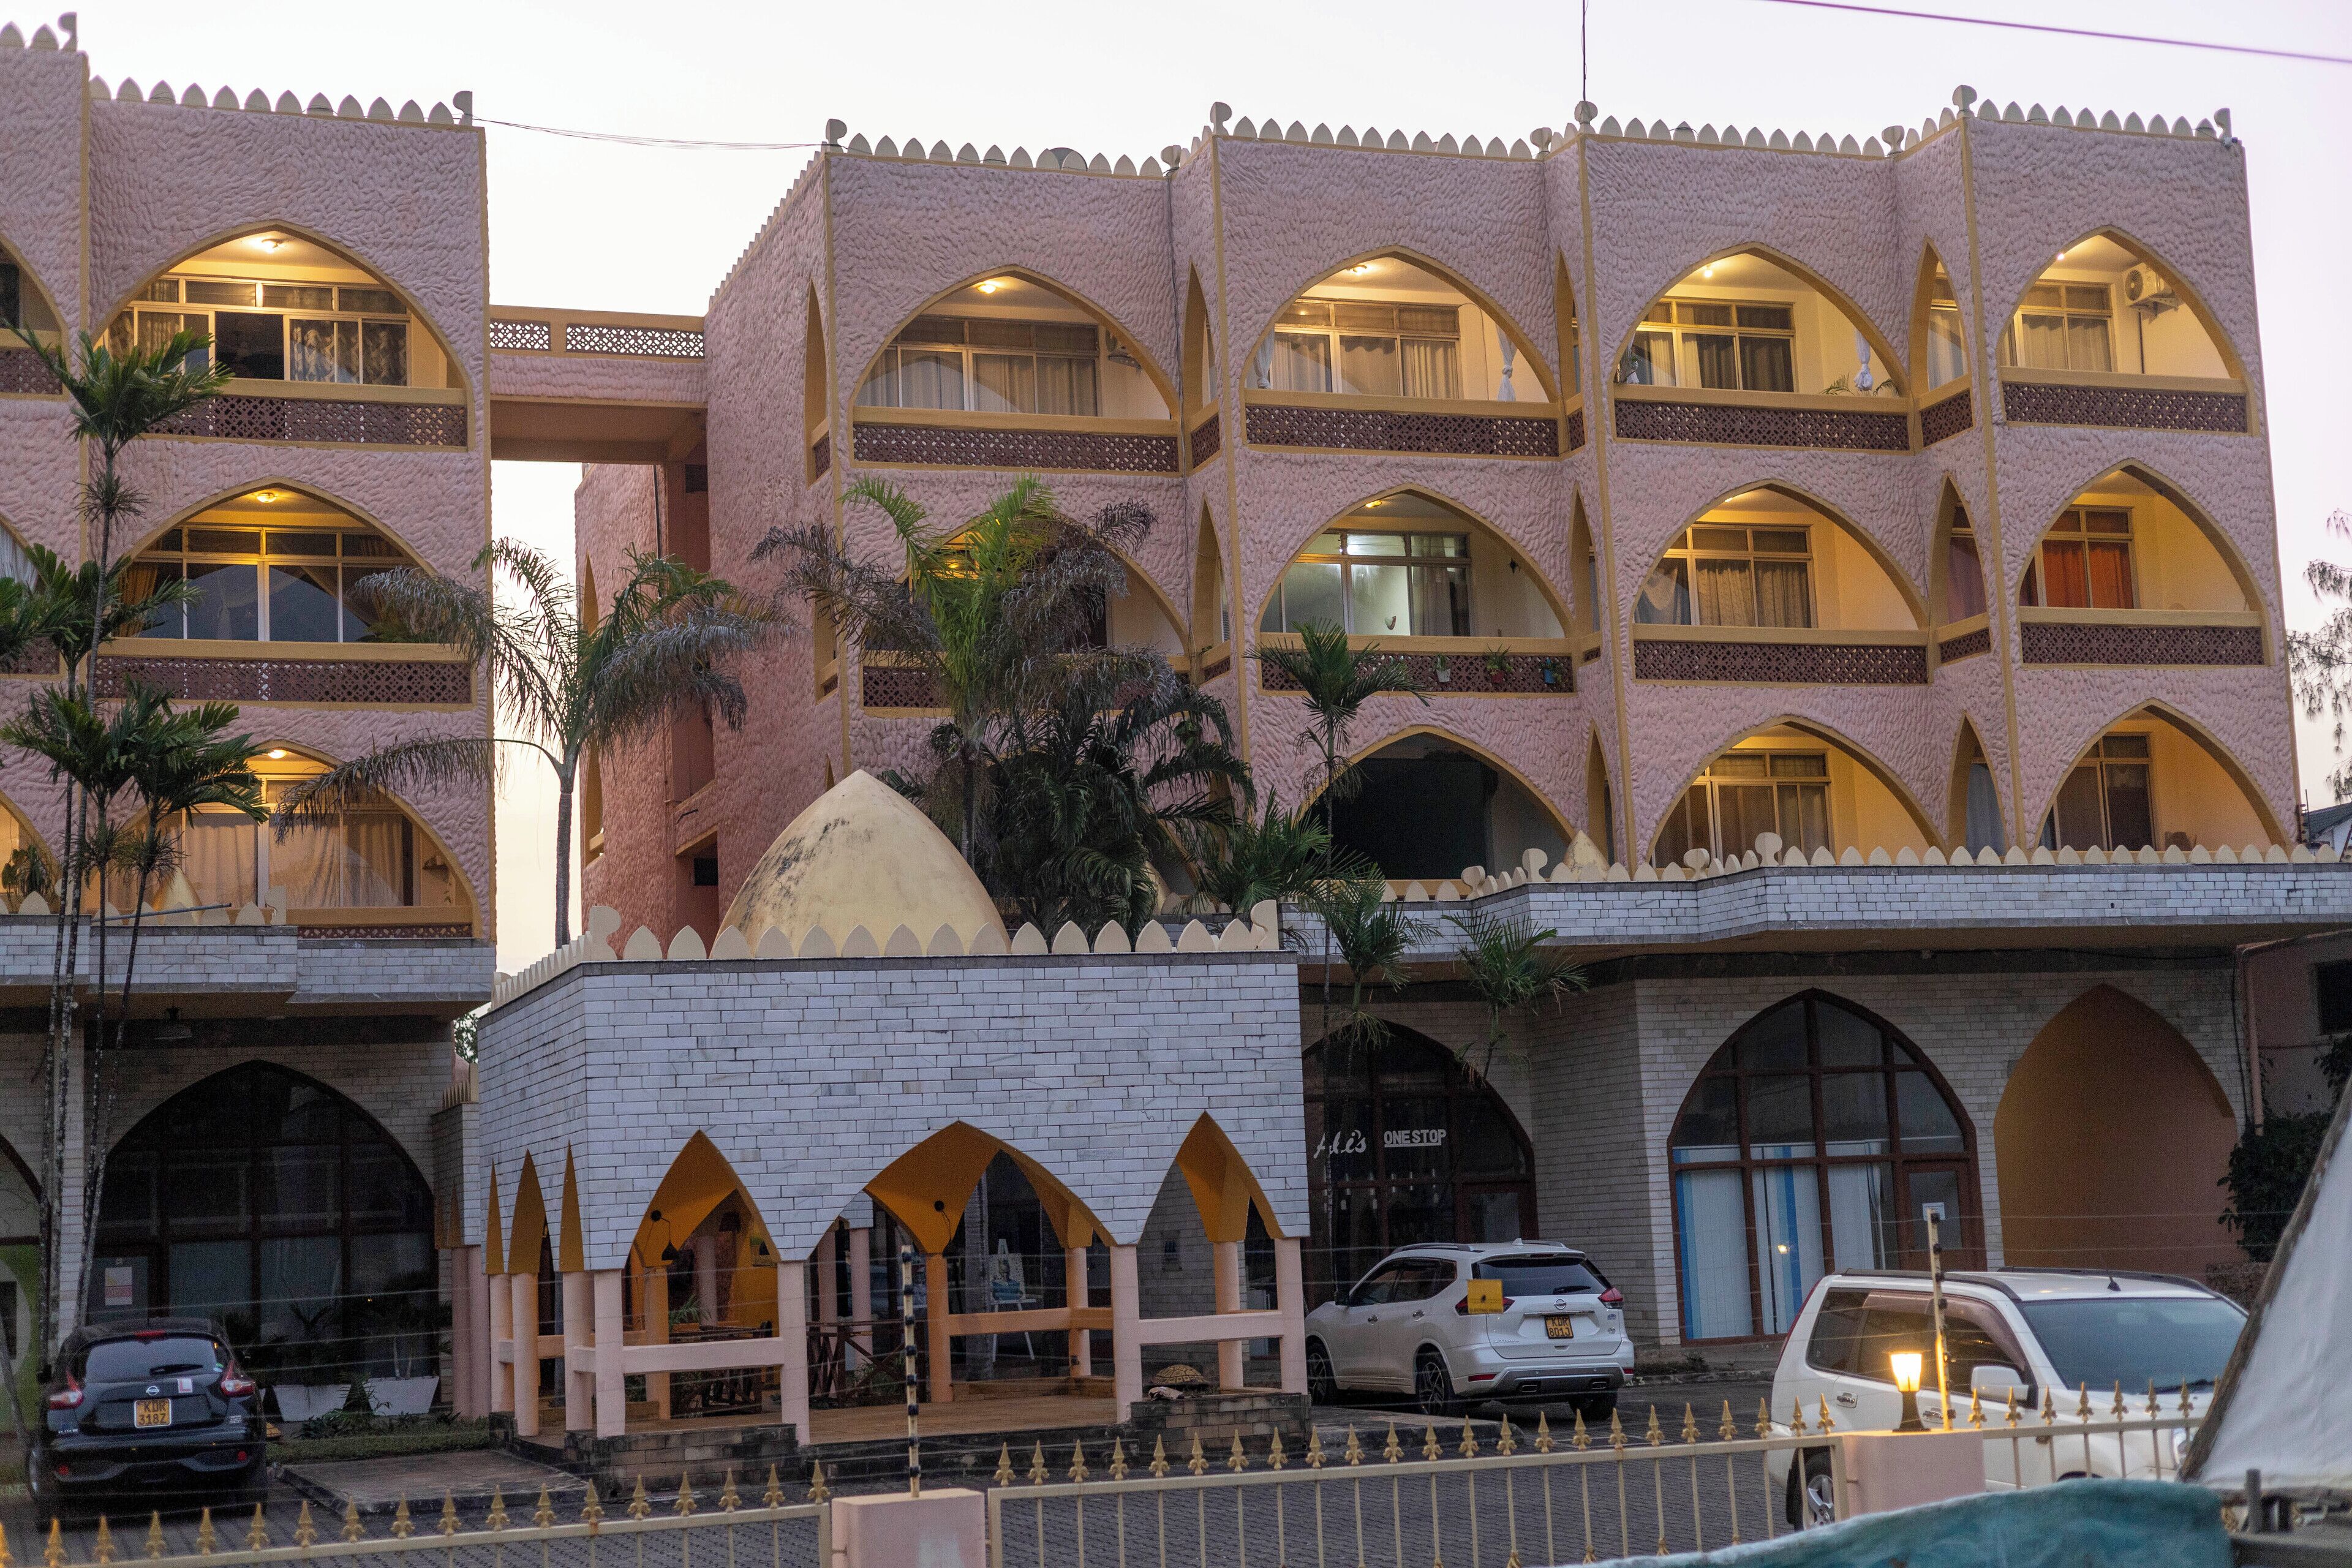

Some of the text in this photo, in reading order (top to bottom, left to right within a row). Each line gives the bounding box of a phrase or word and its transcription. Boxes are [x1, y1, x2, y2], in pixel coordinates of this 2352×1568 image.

[1551, 1316, 1569, 1327] KDR
[144, 1399, 167, 1412] KDR
[138, 1412, 166, 1425] 318Z
